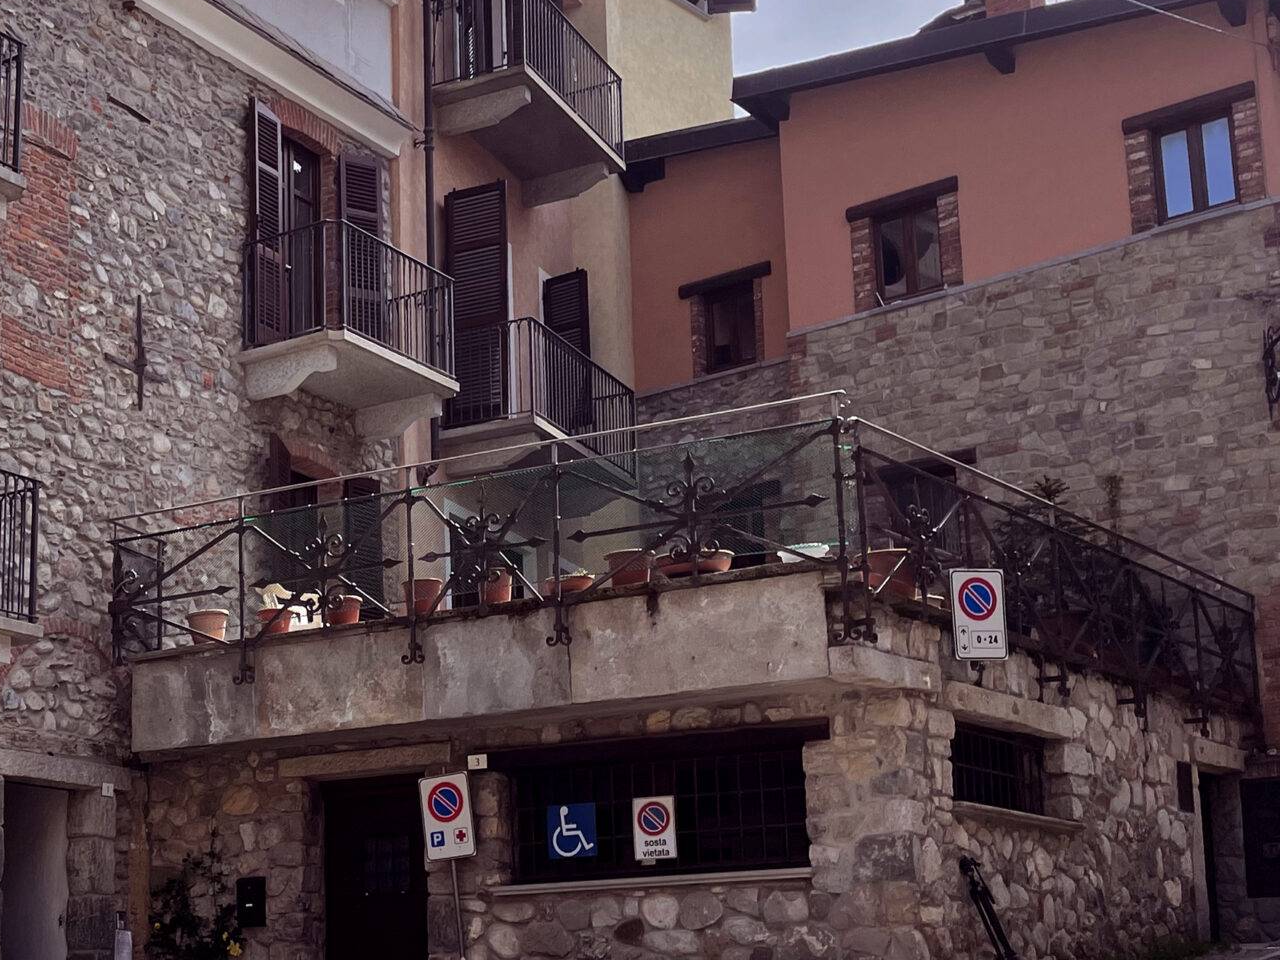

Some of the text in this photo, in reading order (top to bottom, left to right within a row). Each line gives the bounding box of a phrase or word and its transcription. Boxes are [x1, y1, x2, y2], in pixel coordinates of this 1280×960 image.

[976, 635, 982, 644] 0
[988, 635, 998, 644] 24
[474, 757, 480, 767] 3
[433, 833, 442, 845] P
[644, 838, 667, 847] sosta
[642, 848, 670, 858] vietata
